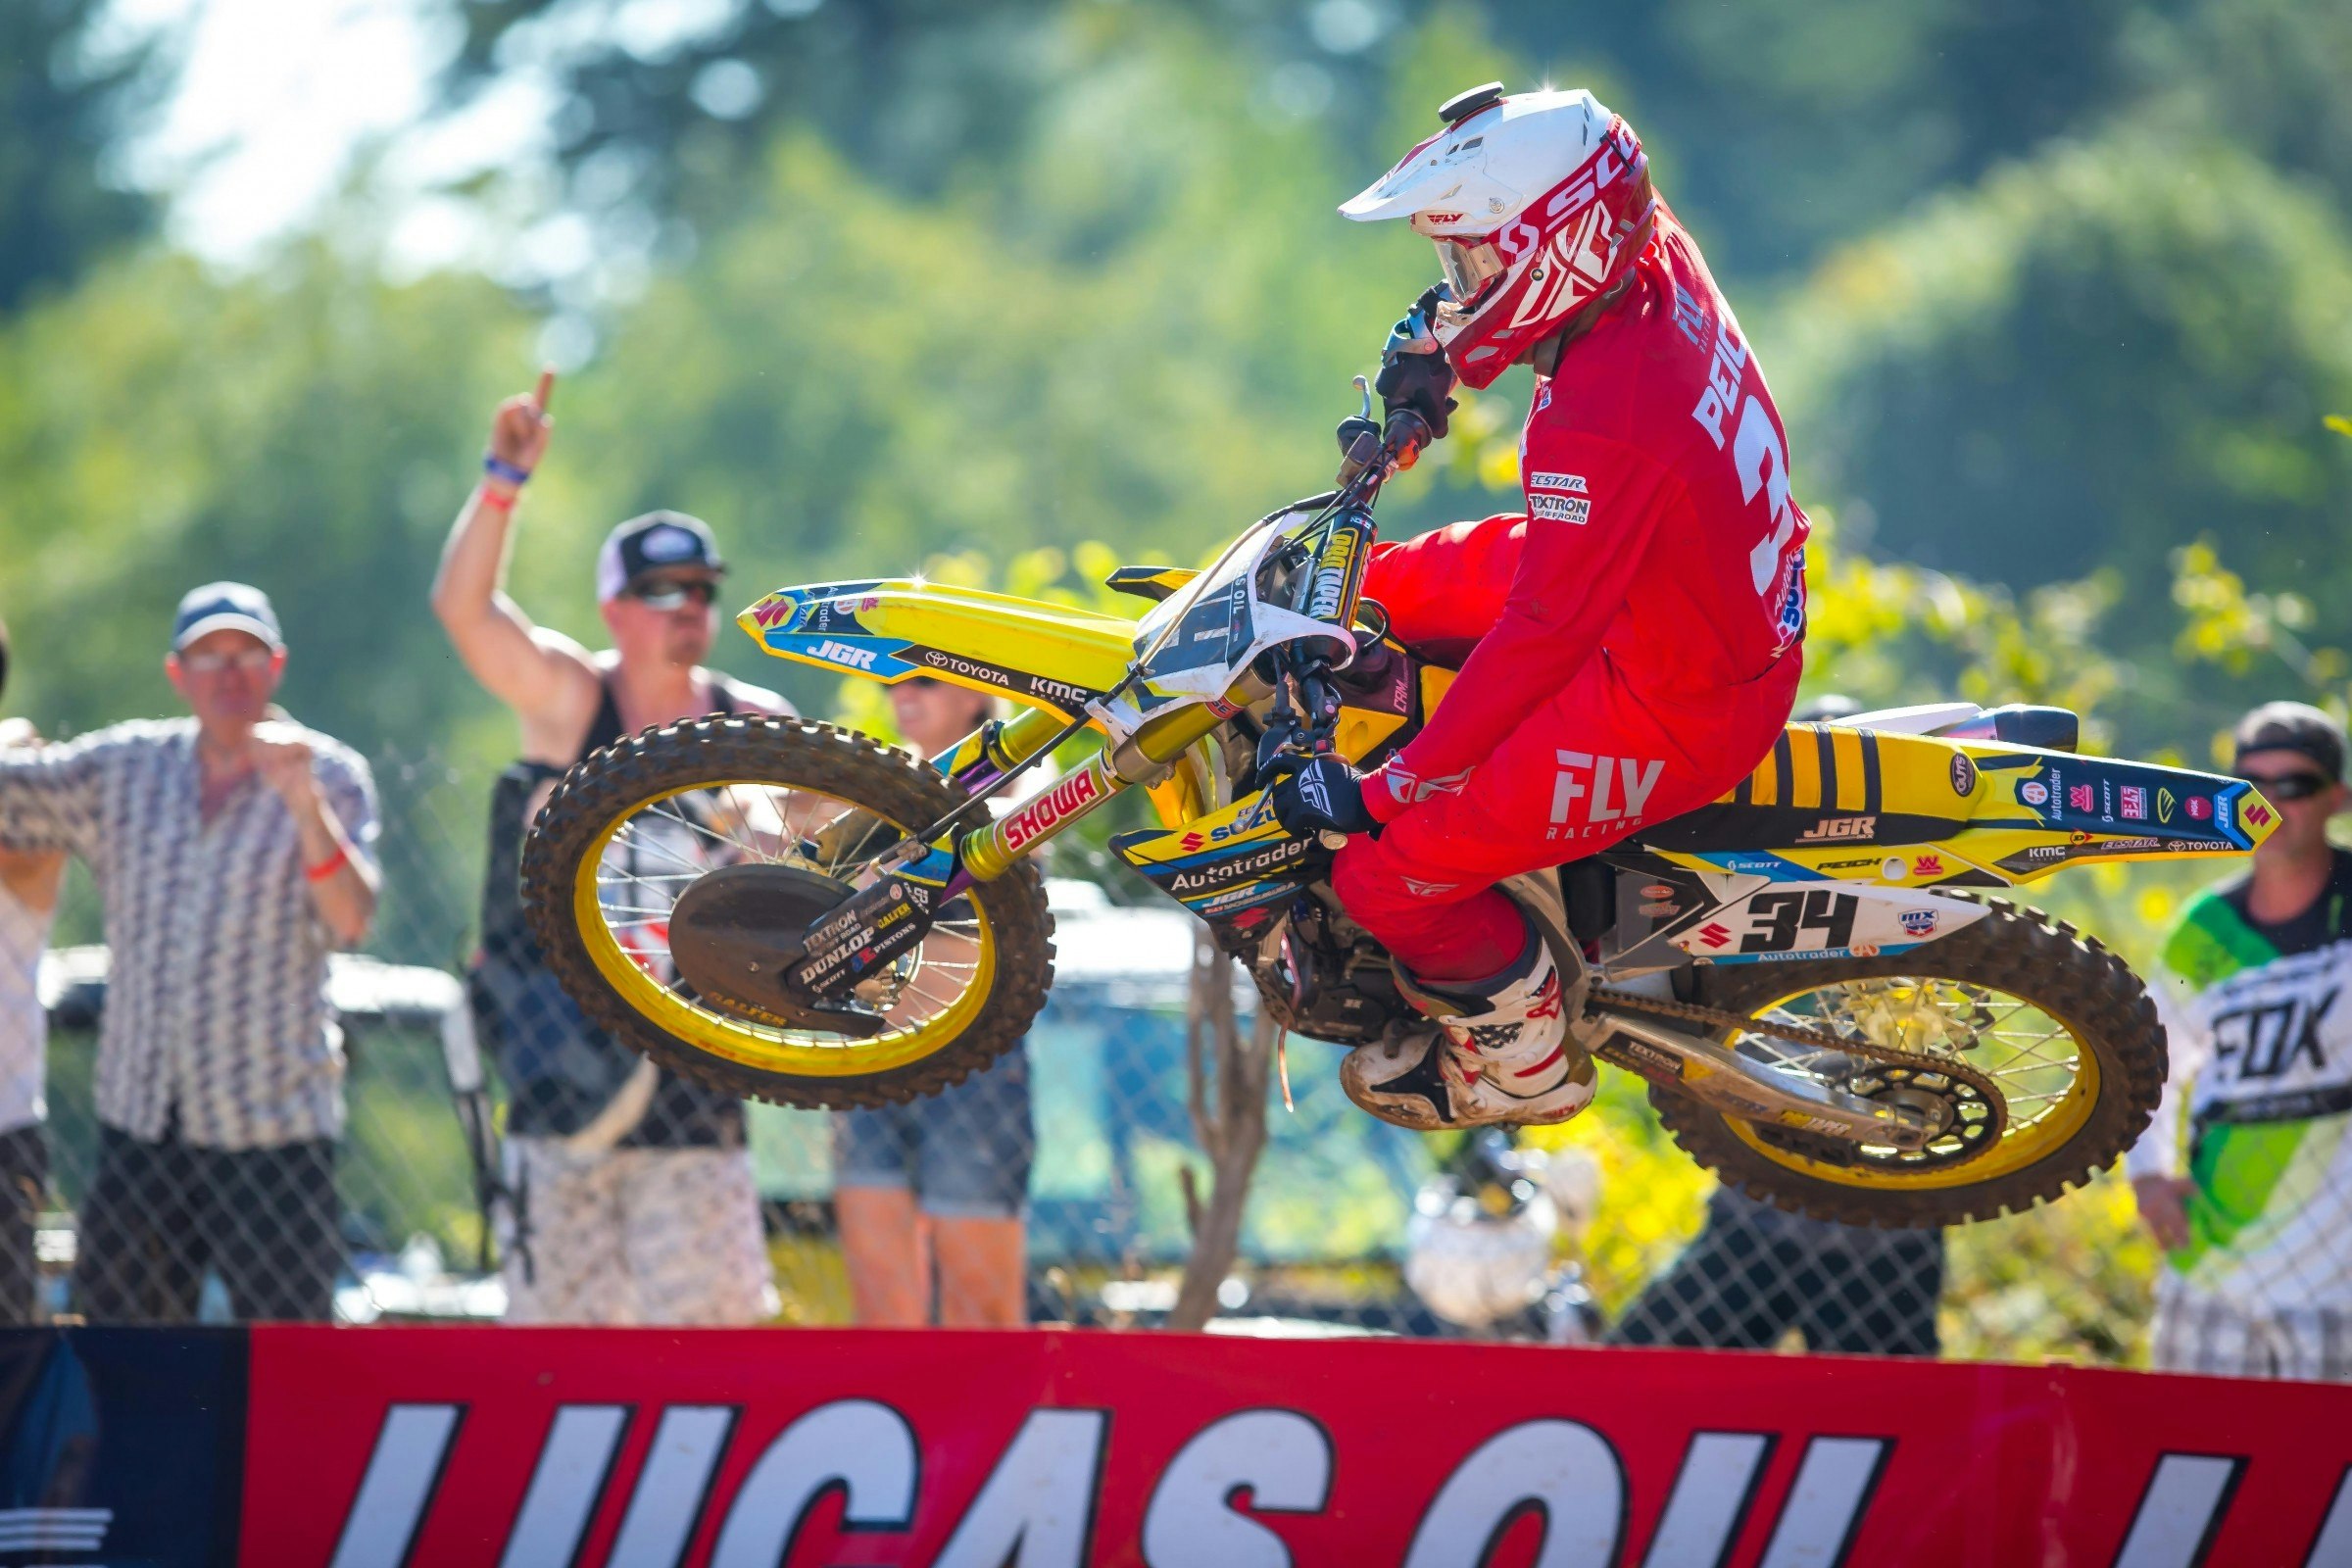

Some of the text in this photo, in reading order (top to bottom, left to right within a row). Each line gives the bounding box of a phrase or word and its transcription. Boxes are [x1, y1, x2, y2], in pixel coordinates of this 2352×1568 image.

[1427, 213, 1464, 222] FLY
[1530, 496, 1588, 514] TXTRON
[807, 640, 877, 670] JGR
[950, 659, 1009, 686] TOYOTA
[1549, 749, 1665, 823] FLY
[2049, 767, 2062, 821] Autotrader
[1004, 768, 1099, 852] SHOWA
[2217, 795, 2229, 828] JGR
[1545, 818, 1642, 841] RACING
[1803, 816, 1877, 839] JGR
[2186, 841, 2234, 850] TOYOTA
[1171, 837, 1313, 891] Autotrader
[1737, 861, 1782, 870] SCOTT
[1202, 886, 1257, 908] JGR
[1740, 890, 1860, 954] 34
[1901, 910, 1935, 922] MX
[874, 923, 916, 954] PISTONS
[800, 926, 875, 985] DUNLOP
[1758, 950, 1846, 961] Autotrader
